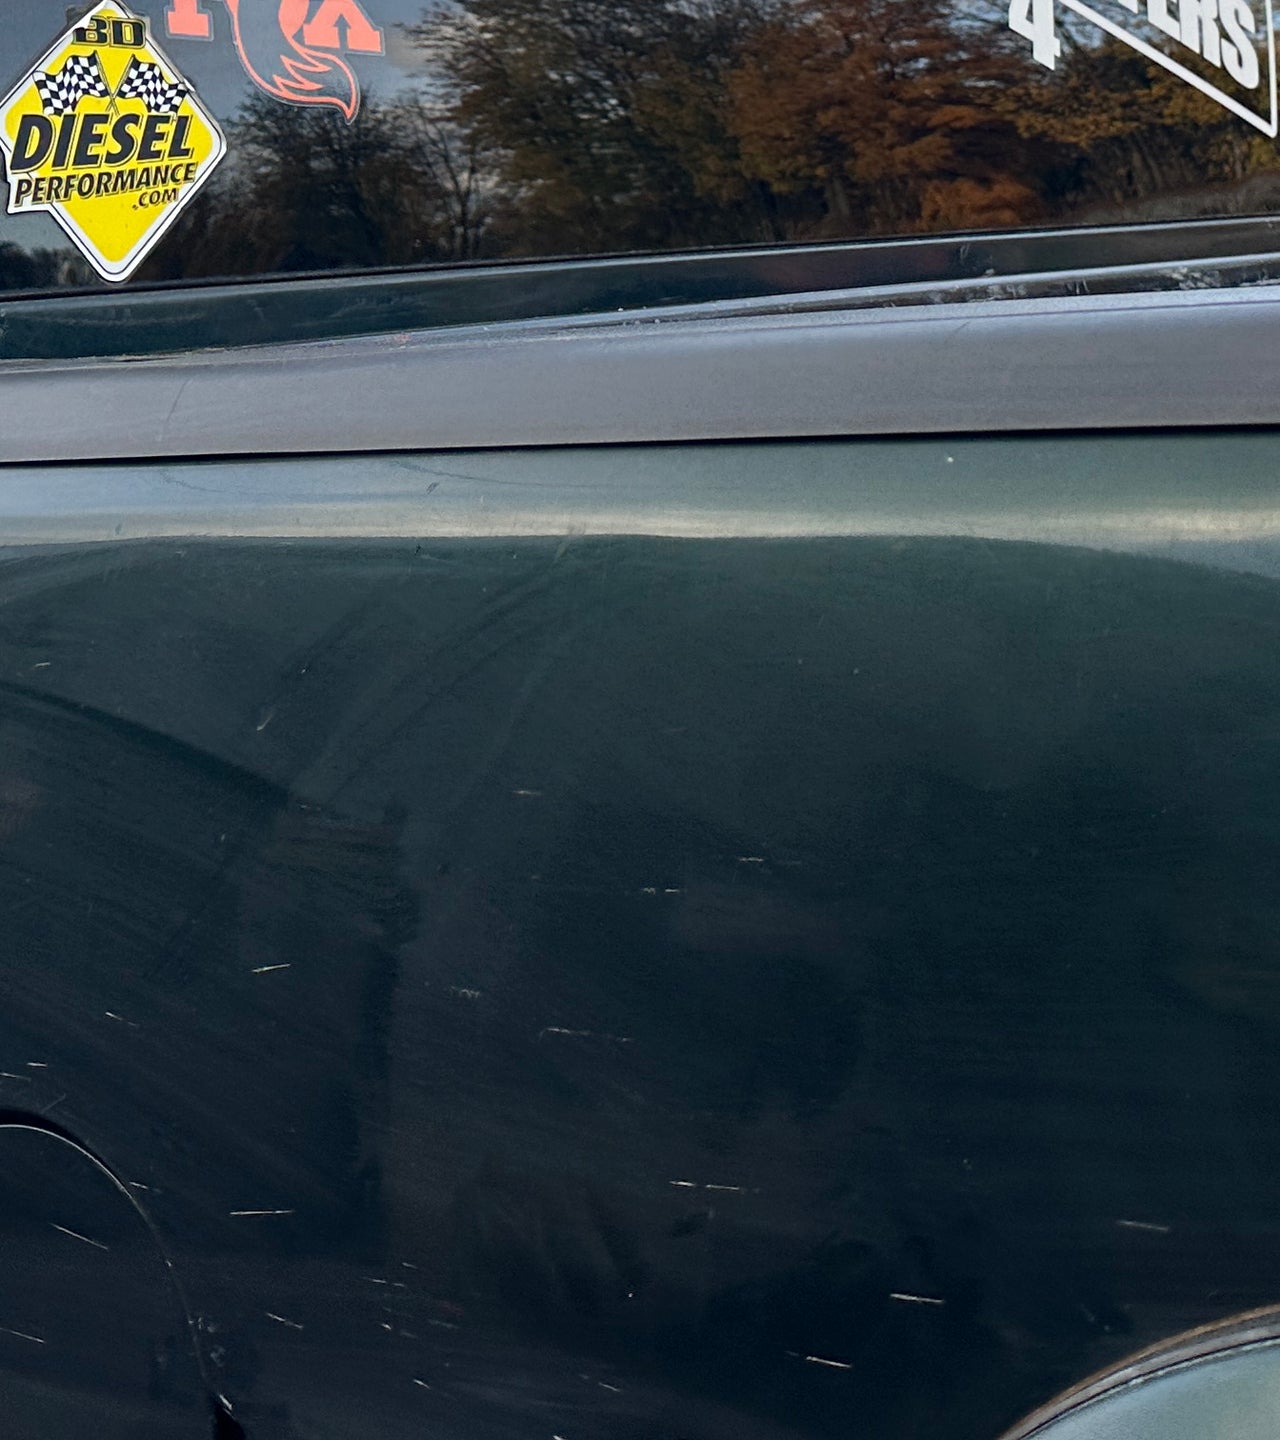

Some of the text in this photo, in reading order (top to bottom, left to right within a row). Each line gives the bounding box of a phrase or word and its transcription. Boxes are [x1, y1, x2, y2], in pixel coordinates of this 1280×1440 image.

[71, 15, 146, 49] BD
[9, 113, 195, 174] DIESEL
[14, 161, 200, 208] PERFORMANCE
[131, 186, 181, 211] .COM
